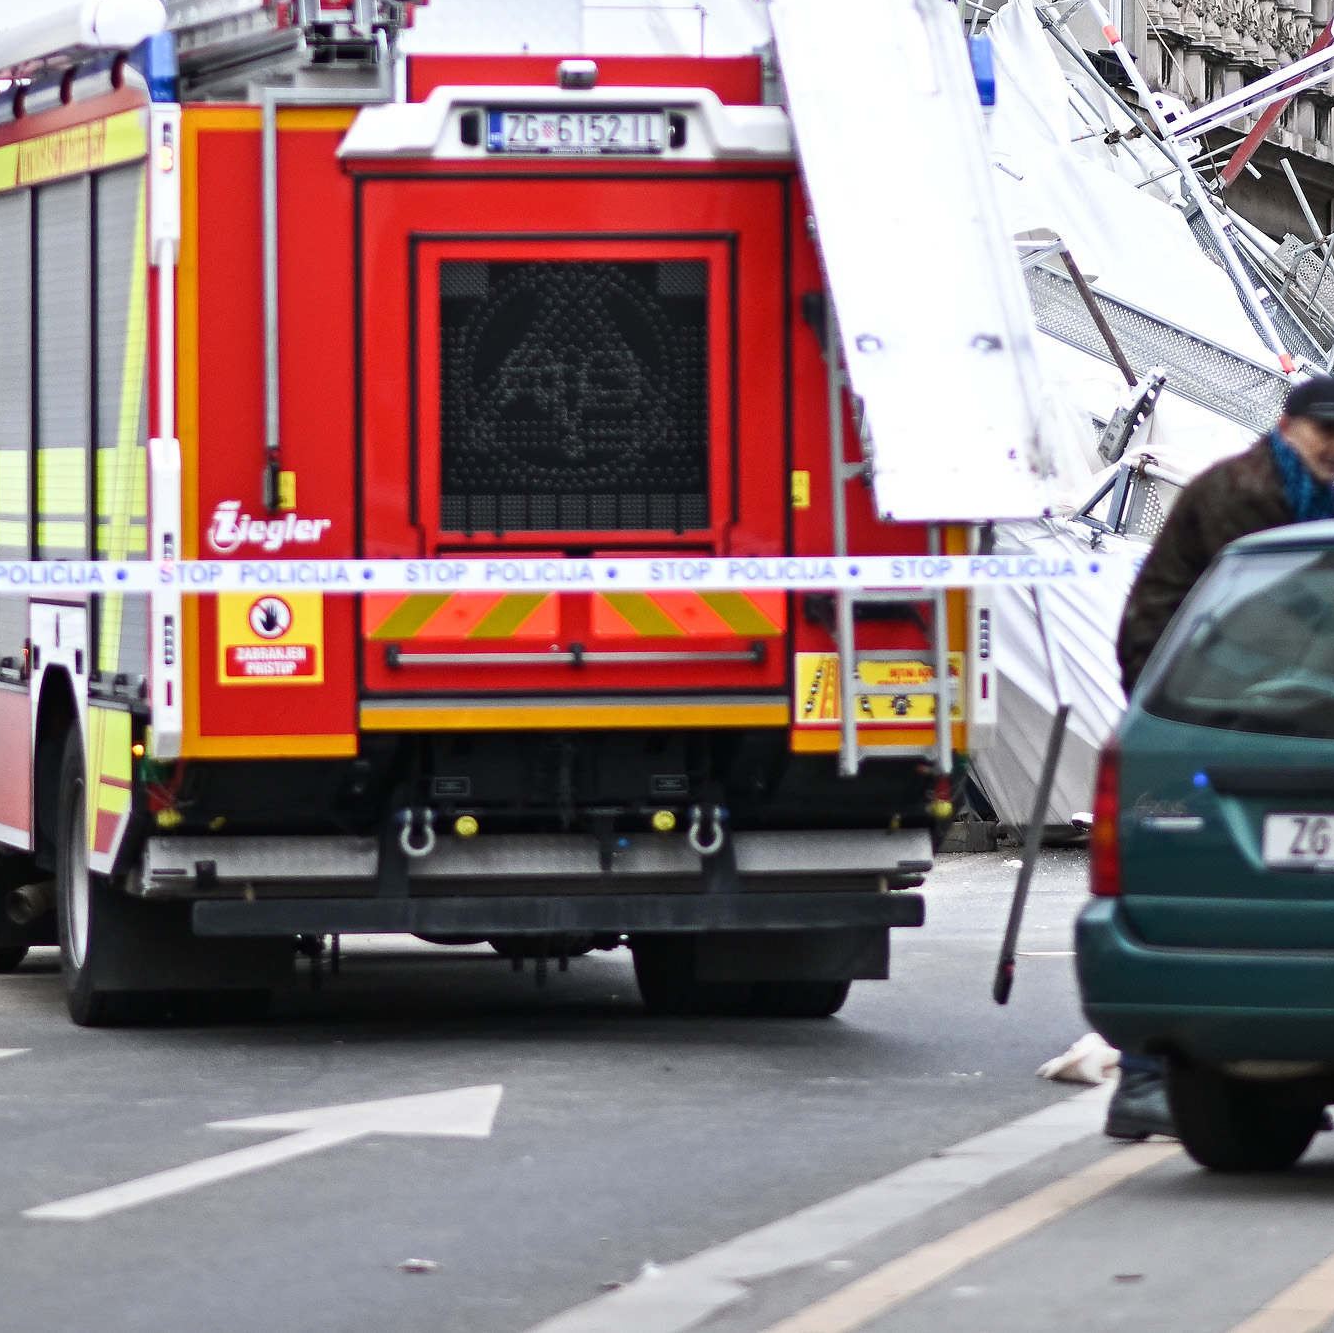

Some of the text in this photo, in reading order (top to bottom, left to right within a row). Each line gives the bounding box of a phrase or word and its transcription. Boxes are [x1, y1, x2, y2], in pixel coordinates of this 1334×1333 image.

[507, 114, 539, 143] ZG
[206, 499, 332, 553] Ziegler
[160, 562, 222, 584] STOP
[239, 563, 350, 583] POLICIJA
[405, 562, 468, 583] STOP
[484, 562, 594, 582] POLICIJA
[649, 561, 712, 581] STOP
[727, 559, 837, 581] POLICIJA
[890, 558, 953, 580] STOP
[969, 554, 1077, 578] POLICIJA
[244, 660, 297, 675] PRISTUP
[1288, 816, 1330, 857] ZG
